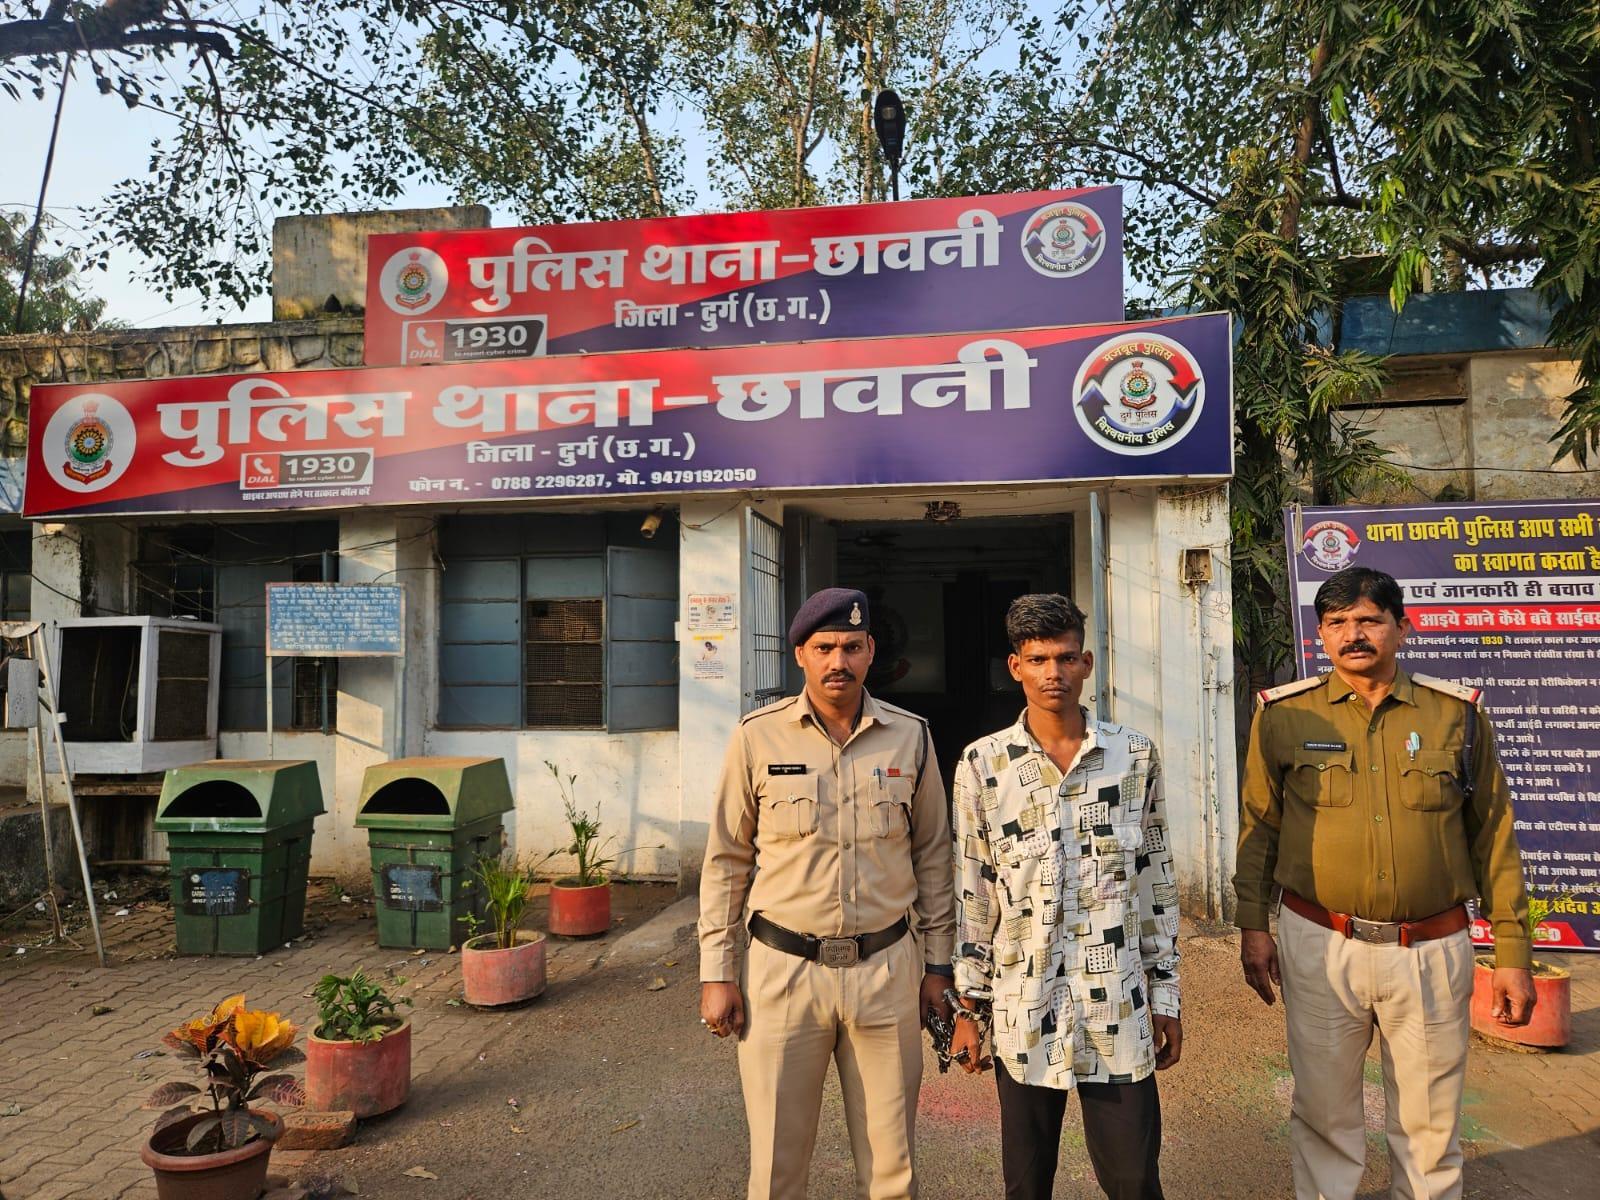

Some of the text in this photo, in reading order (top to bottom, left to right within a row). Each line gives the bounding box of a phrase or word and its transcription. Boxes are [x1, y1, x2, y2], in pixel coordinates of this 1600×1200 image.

[467, 236, 629, 312] पुलिस
[614, 299, 680, 328] जिला
[700, 292, 738, 332] दुर्ग
[452, 325, 528, 348] 1930
[409, 350, 440, 359] DIAL
[1102, 342, 1175, 361] मजबूत पुलिस
[156, 378, 413, 467] पुलिस
[1095, 416, 1175, 444] विश्वसनीय पुलिस
[467, 441, 534, 463] जिला
[557, 436, 598, 467] दुर्ग
[286, 456, 356, 475] 1930
[247, 475, 276, 484] DIAL
[408, 477, 446, 492] फोन
[491, 476, 531, 490] 0788
[617, 469, 646, 485] मो.
[651, 468, 757, 485] 9479192050
[1366, 513, 1594, 546] थाना छावनी पुलिस आप सभी
[1453, 553, 1478, 572] का
[1482, 553, 1536, 571] स्वागत
[1539, 551, 1586, 571] करता
[1410, 580, 1594, 598] एवं जानकारी ही बचाव
[1419, 610, 1460, 627] आइये
[1464, 610, 1495, 626] जाने
[1499, 609, 1526, 626] कैसे
[1530, 609, 1552, 625] बचे
[1406, 637, 1416, 645] पर
[1458, 637, 1479, 645] नम्बर
[1481, 636, 1503, 645] 1930
[1514, 636, 1542, 644] तत्काल
[1544, 636, 1564, 644] काल
[1565, 636, 1579, 644] कर
[1441, 651, 1461, 659] नम्बर
[1479, 651, 1492, 659] कर
[1502, 649, 1531, 659] निकाले
[1462, 676, 1483, 687] किसी
[1485, 676, 1495, 687] भी
[1498, 677, 1526, 687] एकाउंट
[1528, 679, 1539, 687] का
[1540, 706, 1550, 715] या
[1580, 706, 1587, 714] न
[1544, 721, 1575, 729] लगाकर
[1507, 735, 1514, 743] न
[1516, 734, 1535, 743] आये
[1500, 748, 1520, 757] करने
[1521, 748, 1530, 757] के
[1532, 749, 1550, 757] नाम
[1563, 748, 1584, 758] पहले
[1505, 763, 1522, 772] नाम
[1524, 762, 1532, 772] से
[1553, 762, 1576, 772] सकते
[1526, 778, 1533, 786] न
[1535, 777, 1553, 786] आये
[1547, 821, 1577, 831] एटीएम
[1578, 821, 1587, 831] से
[1552, 850, 1562, 860] के
[1538, 865, 1549, 875] भी
[1551, 866, 1577, 876] आपके
[1580, 869, 1598, 877] साथ
